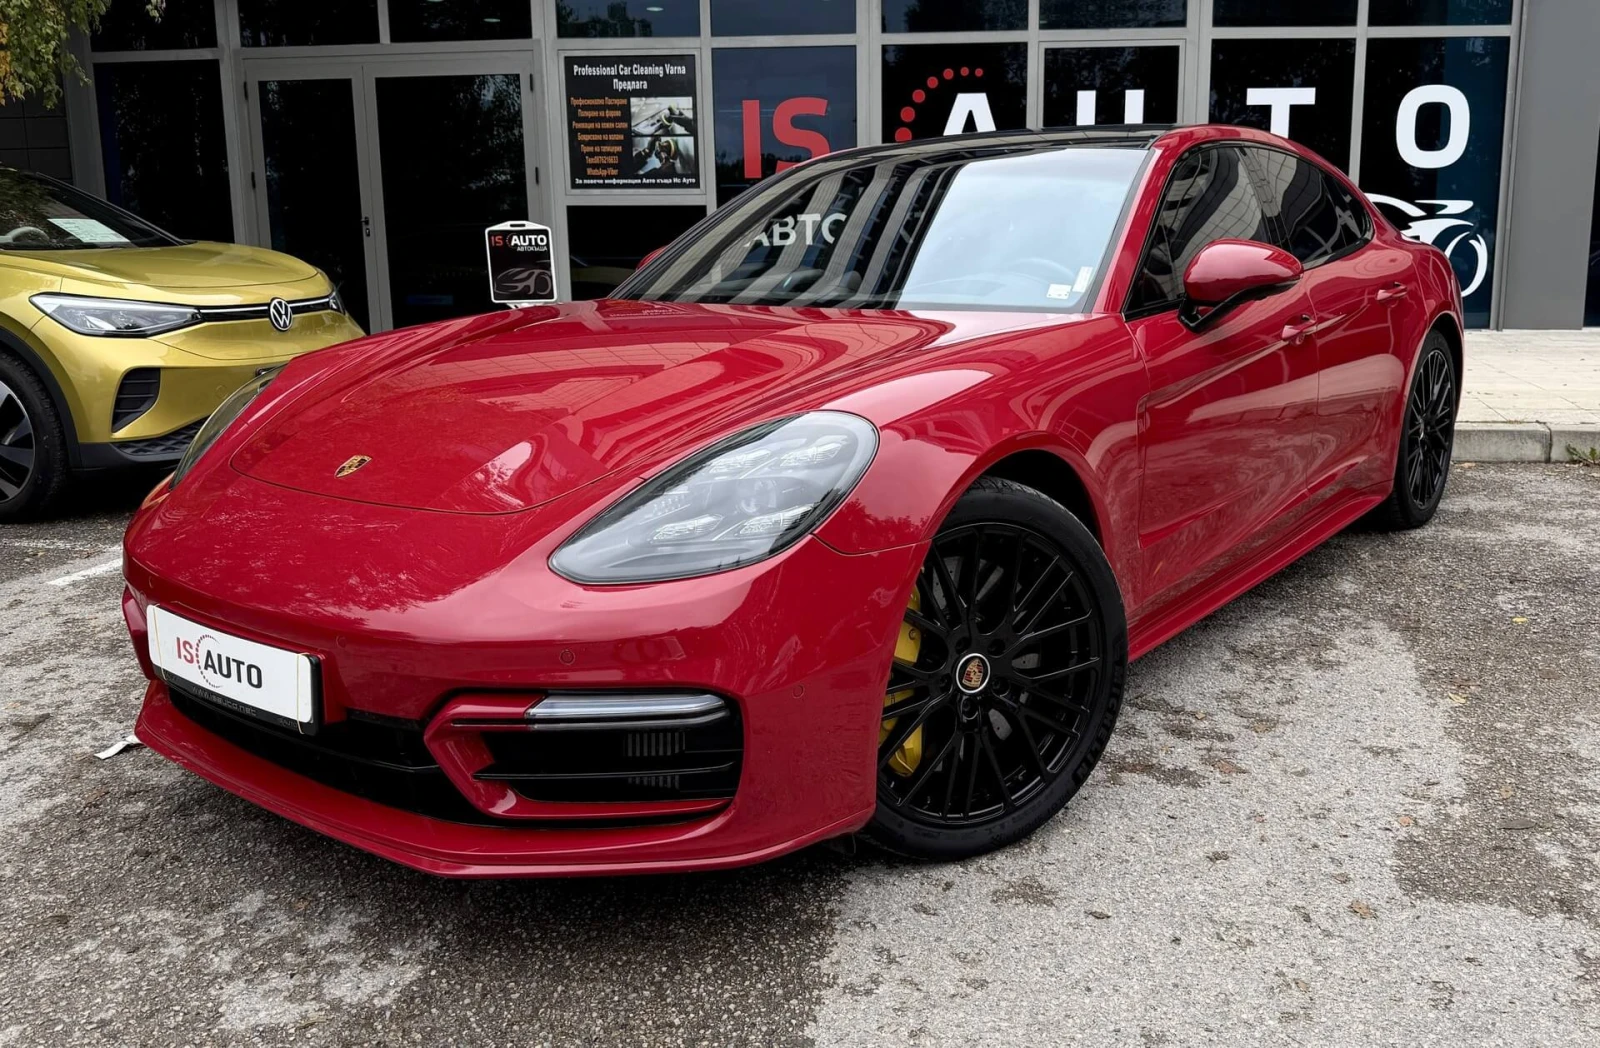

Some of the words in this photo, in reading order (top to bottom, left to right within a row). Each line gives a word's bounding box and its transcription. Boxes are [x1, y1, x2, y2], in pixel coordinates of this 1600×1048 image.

[573, 64, 617, 76] Professional
[618, 64, 631, 75] Car
[632, 64, 664, 77] Cleaning
[664, 63, 686, 75] Varna
[613, 78, 648, 91] Предлага
[742, 97, 830, 178] IS
[491, 235, 504, 247] IS
[511, 234, 547, 246] AUTO
[176, 637, 194, 664] IS
[204, 650, 262, 689] AUTO
